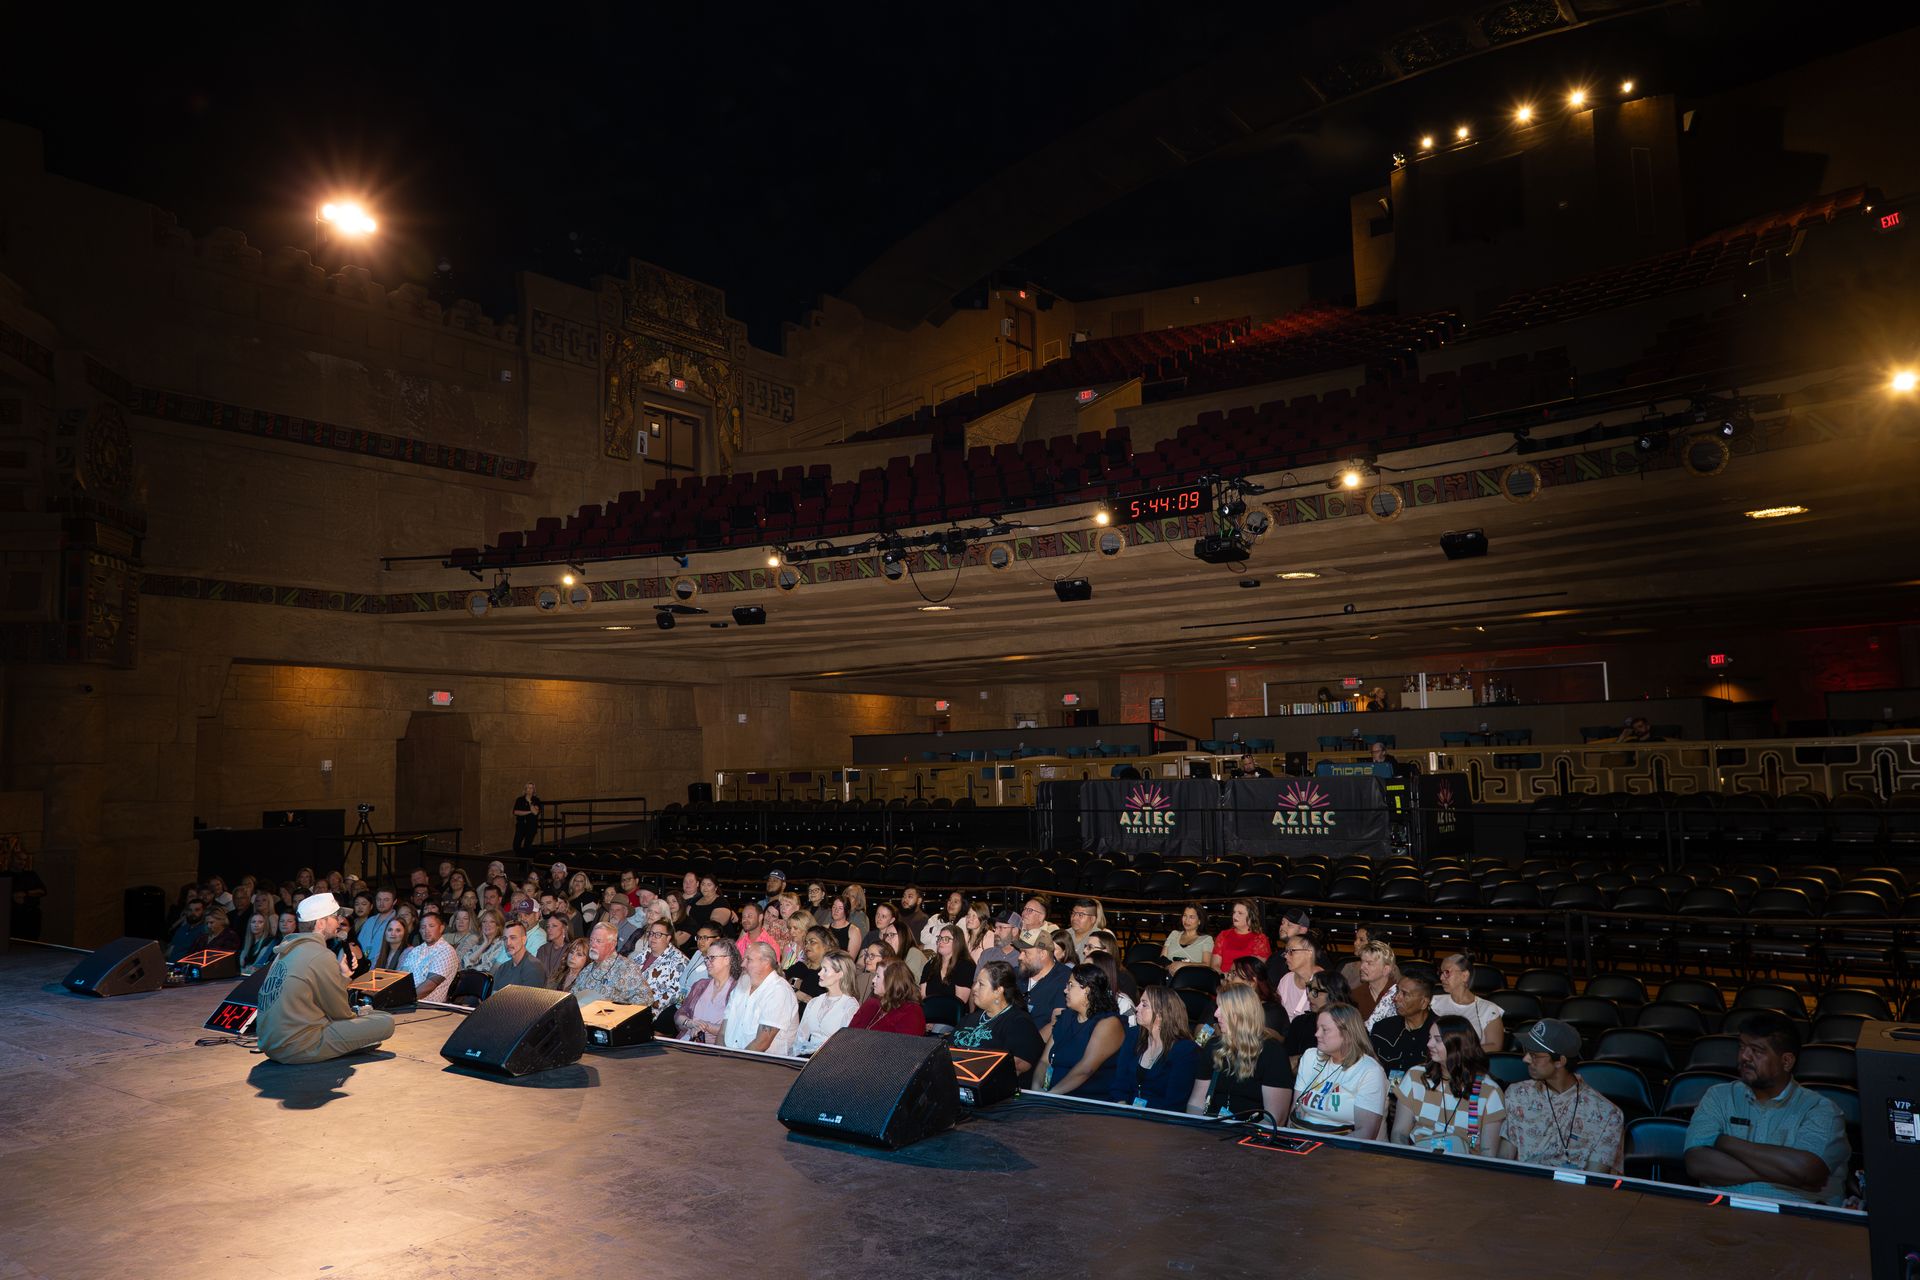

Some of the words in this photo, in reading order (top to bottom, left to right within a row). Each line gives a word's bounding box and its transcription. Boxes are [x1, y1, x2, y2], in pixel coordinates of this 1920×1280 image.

[1880, 212, 1899, 229] EXIT
[1131, 491, 1200, 516] 5:44:09
[1710, 654, 1725, 665] EXIT
[1331, 766, 1374, 776] MIDAS
[1119, 807, 1176, 826] AZTEC
[1271, 807, 1337, 826] AZTEC
[1126, 826, 1170, 834] THEATRE
[1280, 826, 1330, 835] THEATRE
[1894, 1100, 1912, 1110] V7P
